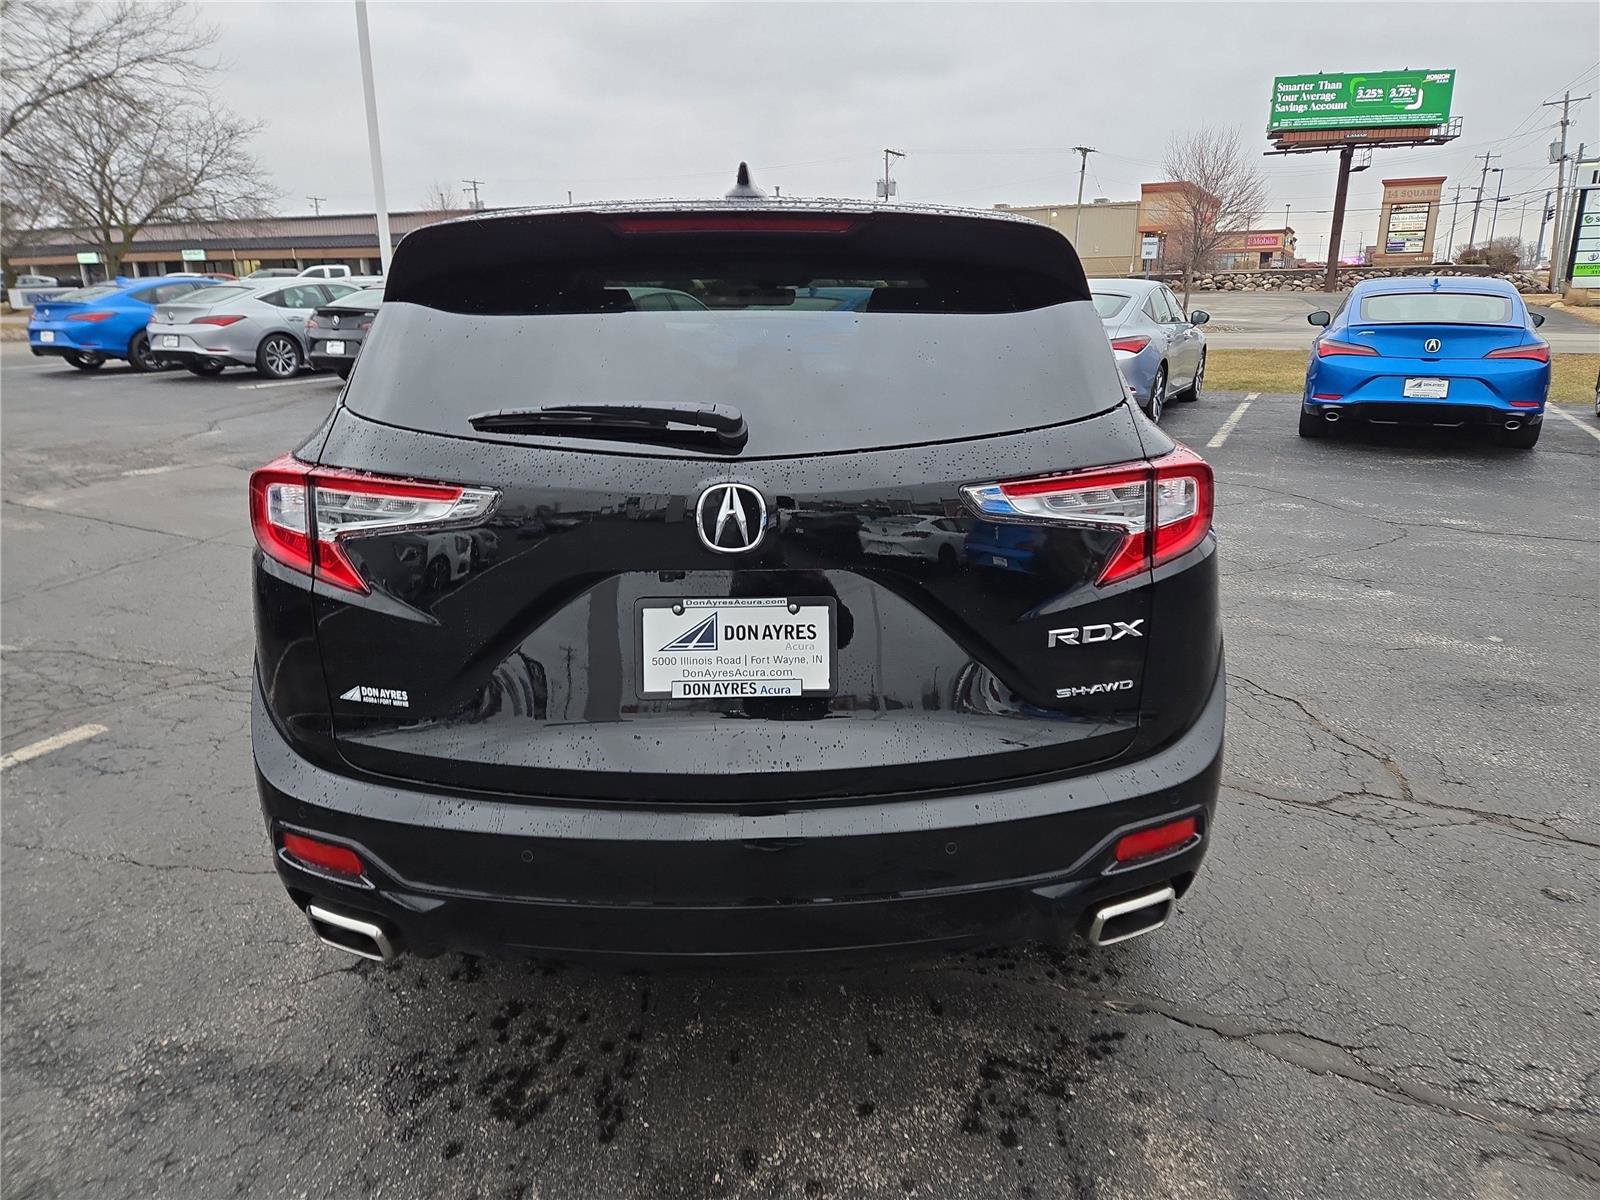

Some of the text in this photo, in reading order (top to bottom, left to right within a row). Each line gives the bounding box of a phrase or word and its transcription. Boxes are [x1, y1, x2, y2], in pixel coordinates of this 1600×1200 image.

[1278, 81, 1342, 91] Smarter Than
[1277, 92, 1336, 102] Your Average
[1275, 101, 1348, 113] Savings Account
[724, 623, 817, 641] DON AYRES
[1048, 618, 1144, 648] RDX
[785, 642, 815, 651] Acura
[652, 655, 823, 666] 5000 Illinois Road Fort Wayne, IN
[682, 668, 793, 680] DonAyresAcura.com
[361, 686, 408, 701] DON AYRES
[683, 682, 791, 696] DON AYRES Acura
